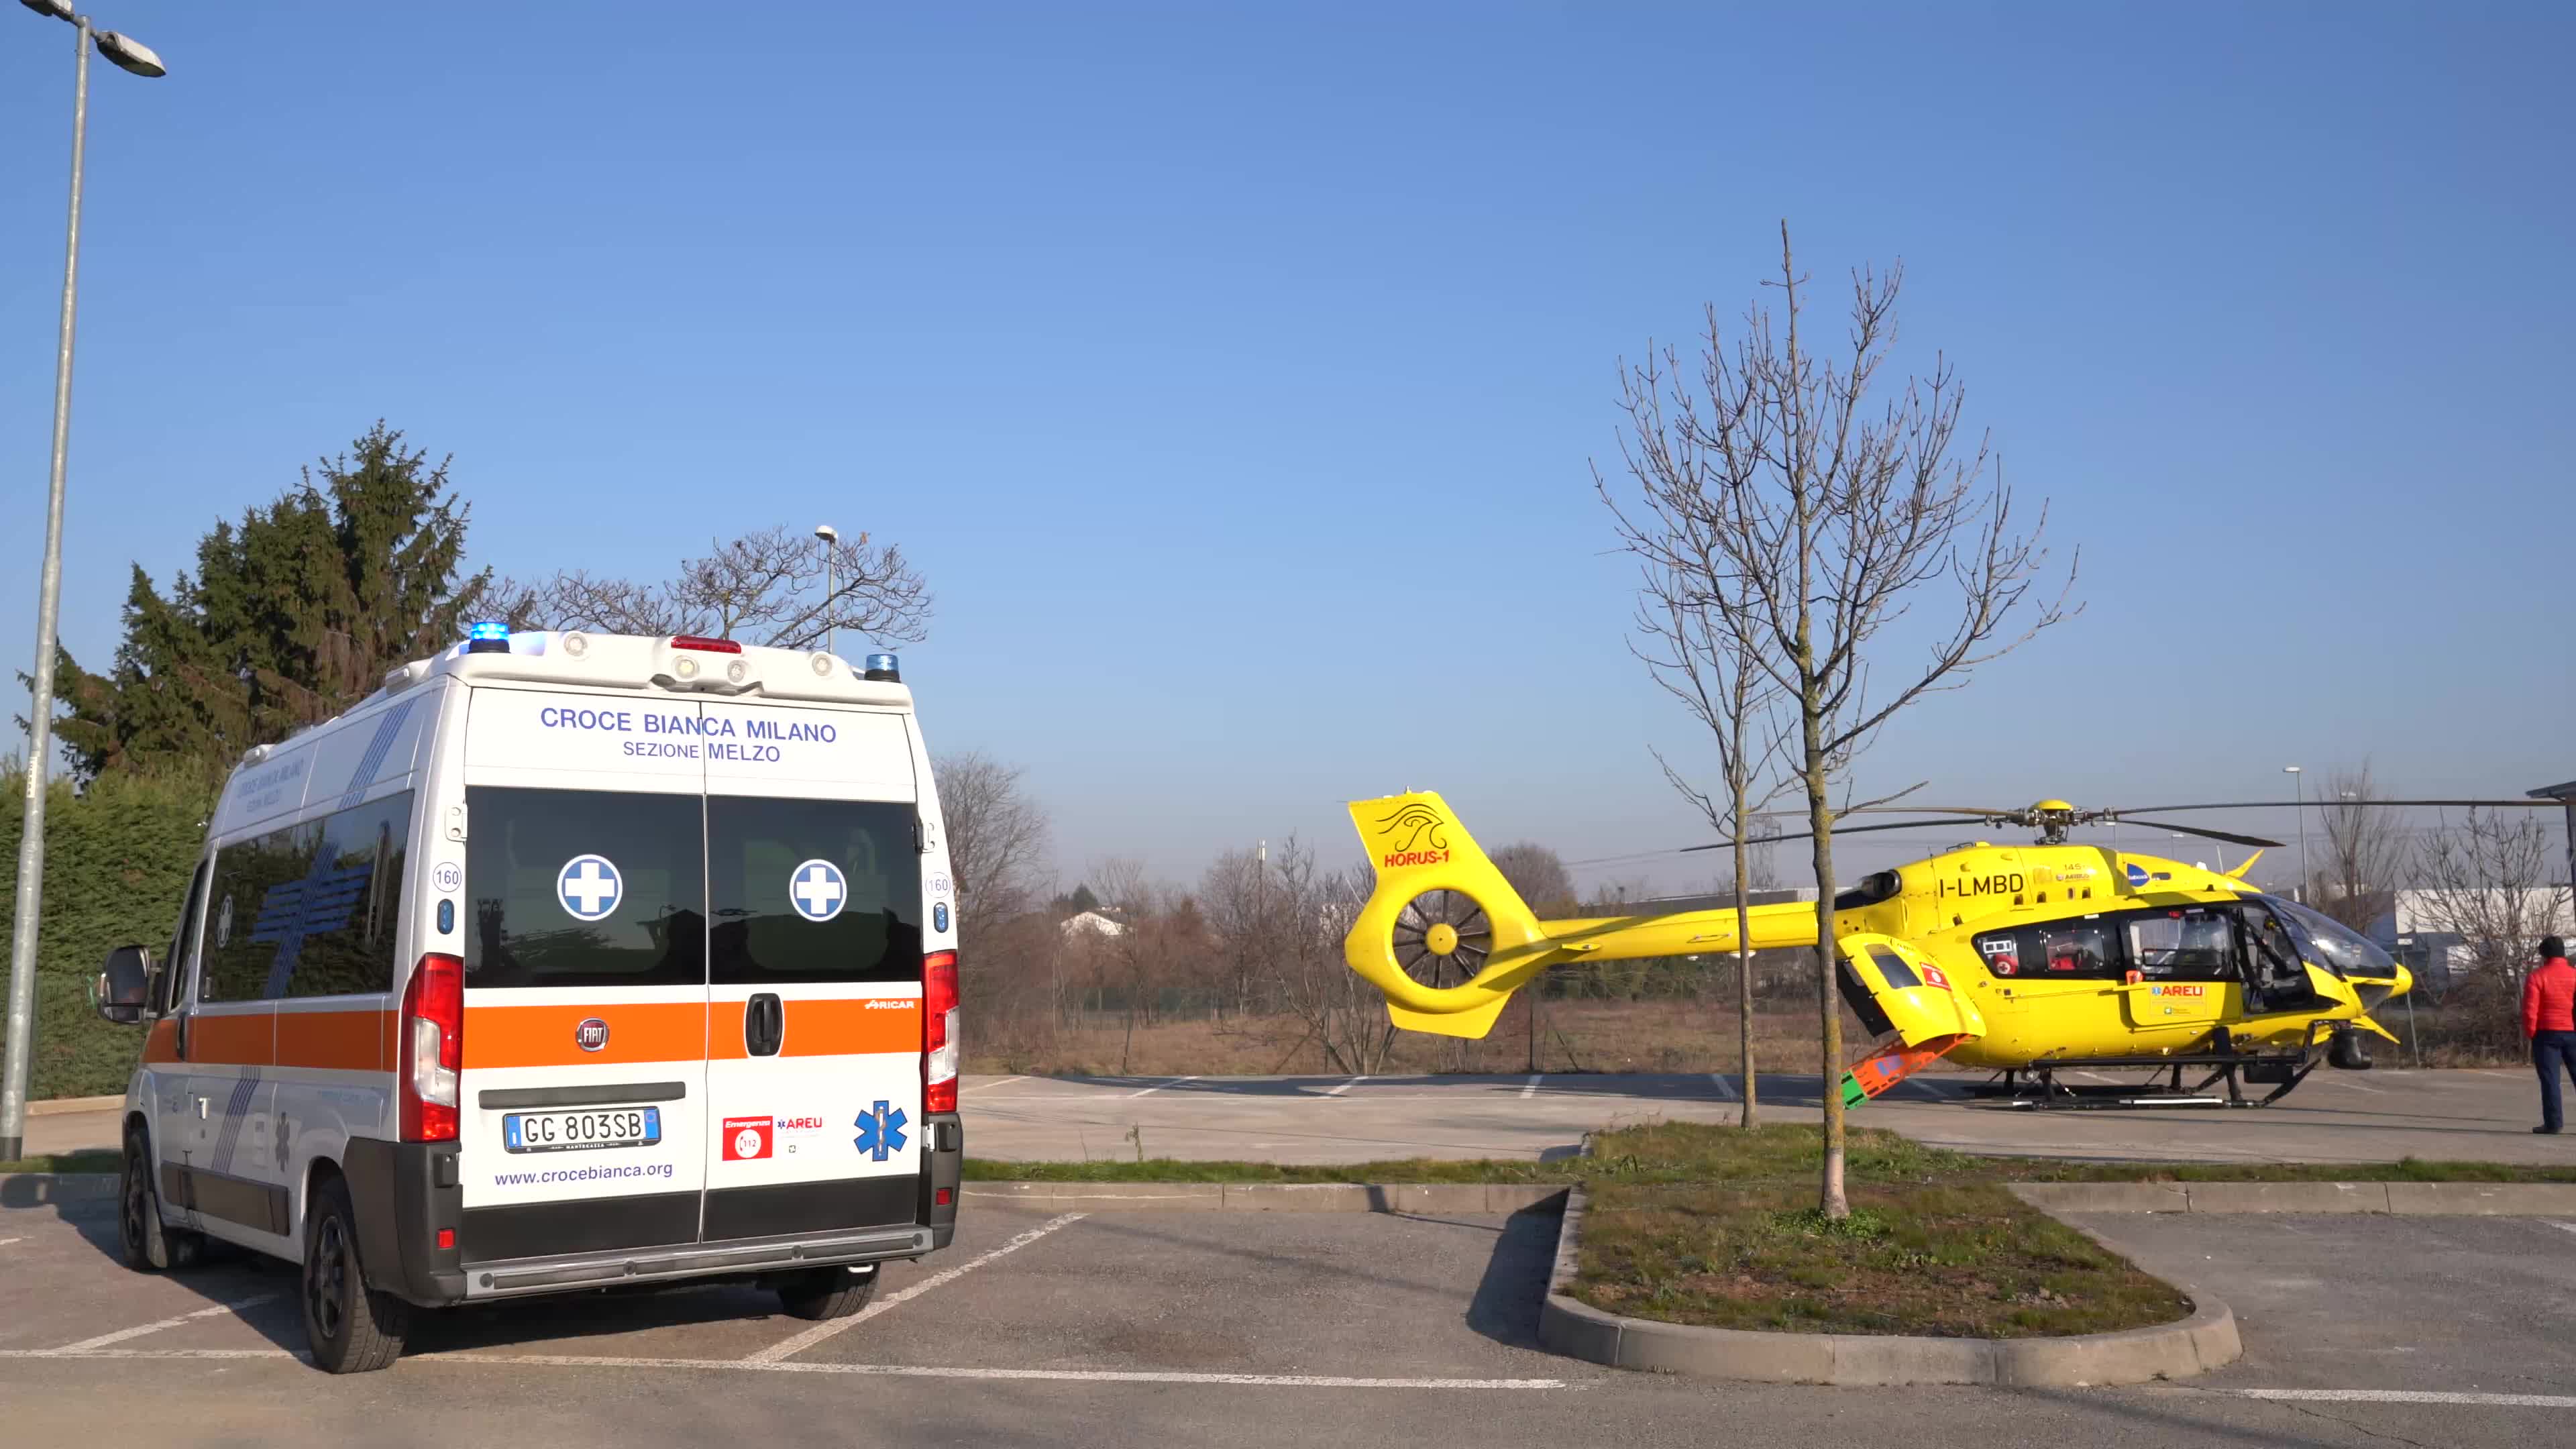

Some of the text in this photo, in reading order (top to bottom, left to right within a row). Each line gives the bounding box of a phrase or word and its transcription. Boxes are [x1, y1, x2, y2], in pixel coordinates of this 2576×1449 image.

[541, 707, 837, 743] CROCE BIANCA MILANO
[623, 741, 781, 762] SEZIONE MELZO
[1384, 849, 1449, 867] HORUS-1
[436, 869, 459, 885] 160
[929, 879, 948, 891] 160
[1939, 873, 2023, 898] I-LMBD
[2161, 985, 2203, 996] AREU
[584, 1027, 603, 1042] FIAT
[525, 1117, 555, 1142] GG
[566, 1113, 641, 1140] 803SB
[786, 1117, 822, 1129] AREU
[744, 1140, 756, 1148] 112
[494, 1164, 673, 1185] www.crocebianca.org
